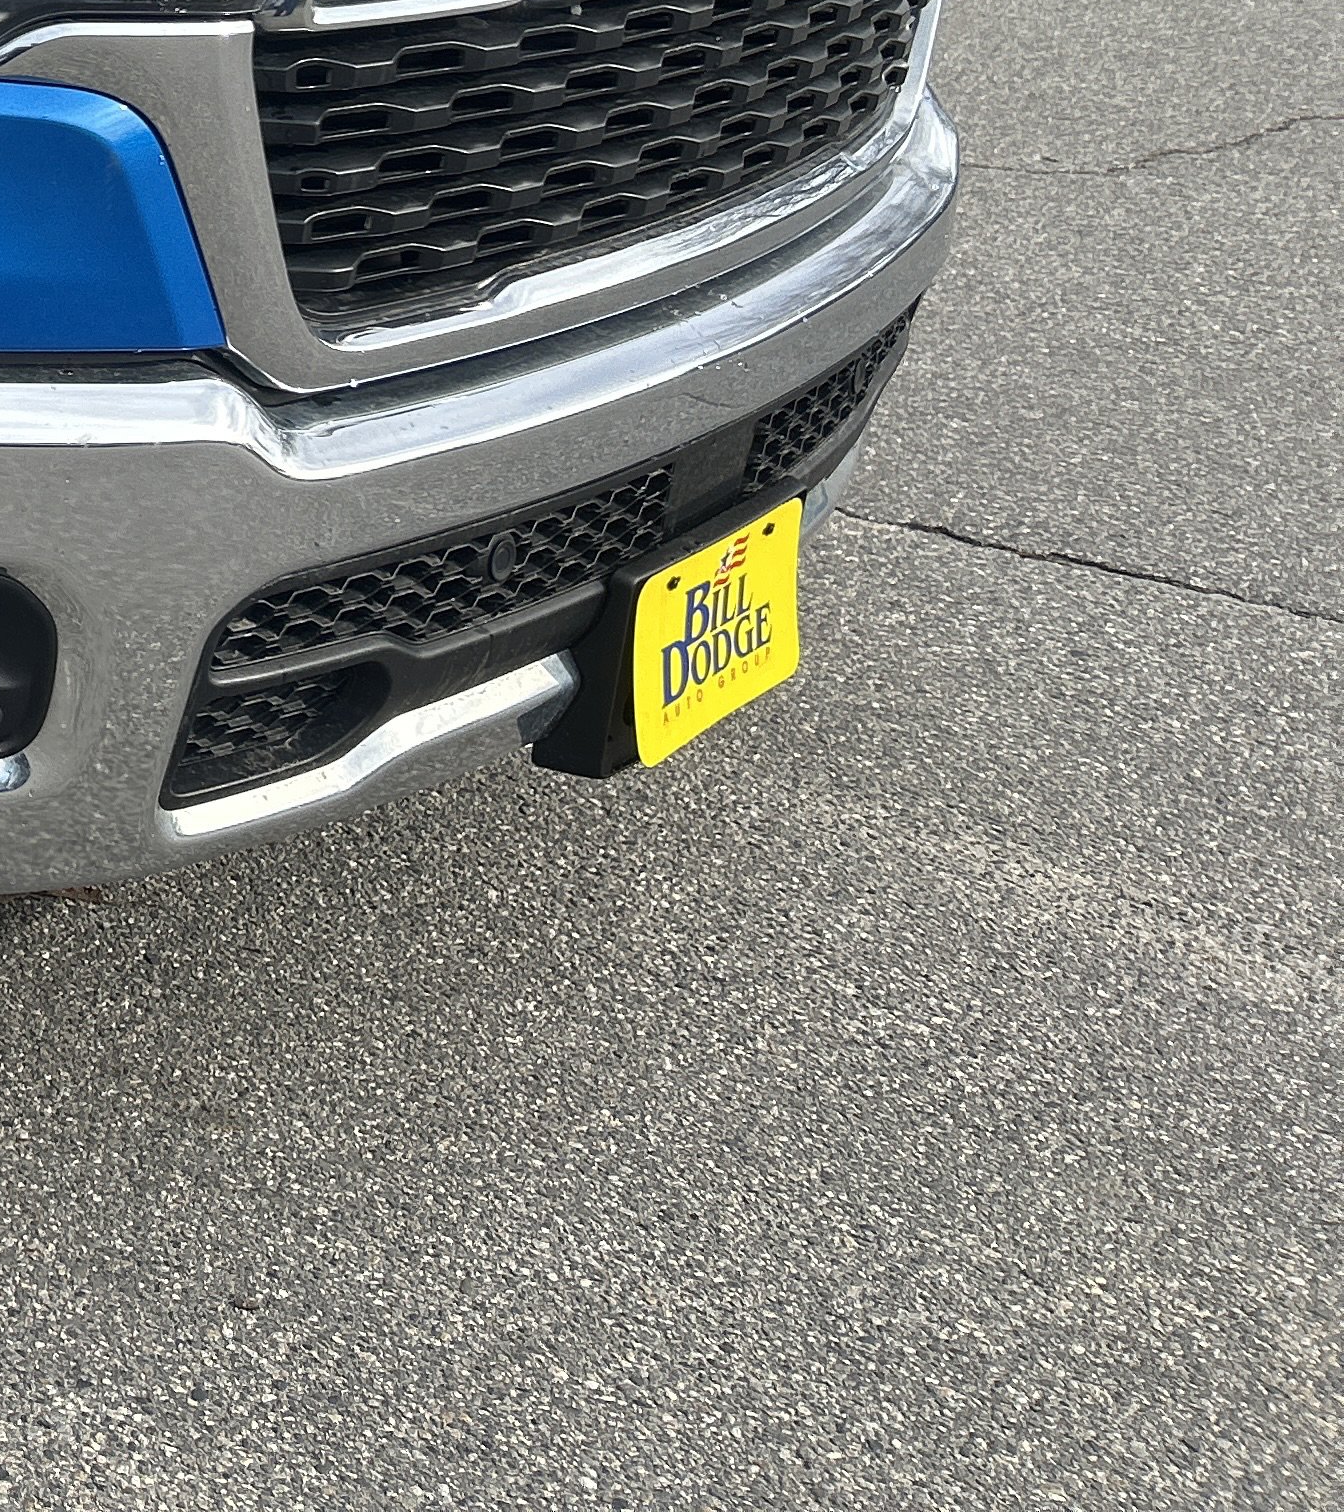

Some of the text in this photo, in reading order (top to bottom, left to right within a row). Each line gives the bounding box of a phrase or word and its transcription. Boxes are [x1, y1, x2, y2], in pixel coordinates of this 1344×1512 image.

[684, 574, 754, 643] BILL
[662, 603, 772, 708] DODGE
[662, 646, 772, 726] AUTO GROUP
